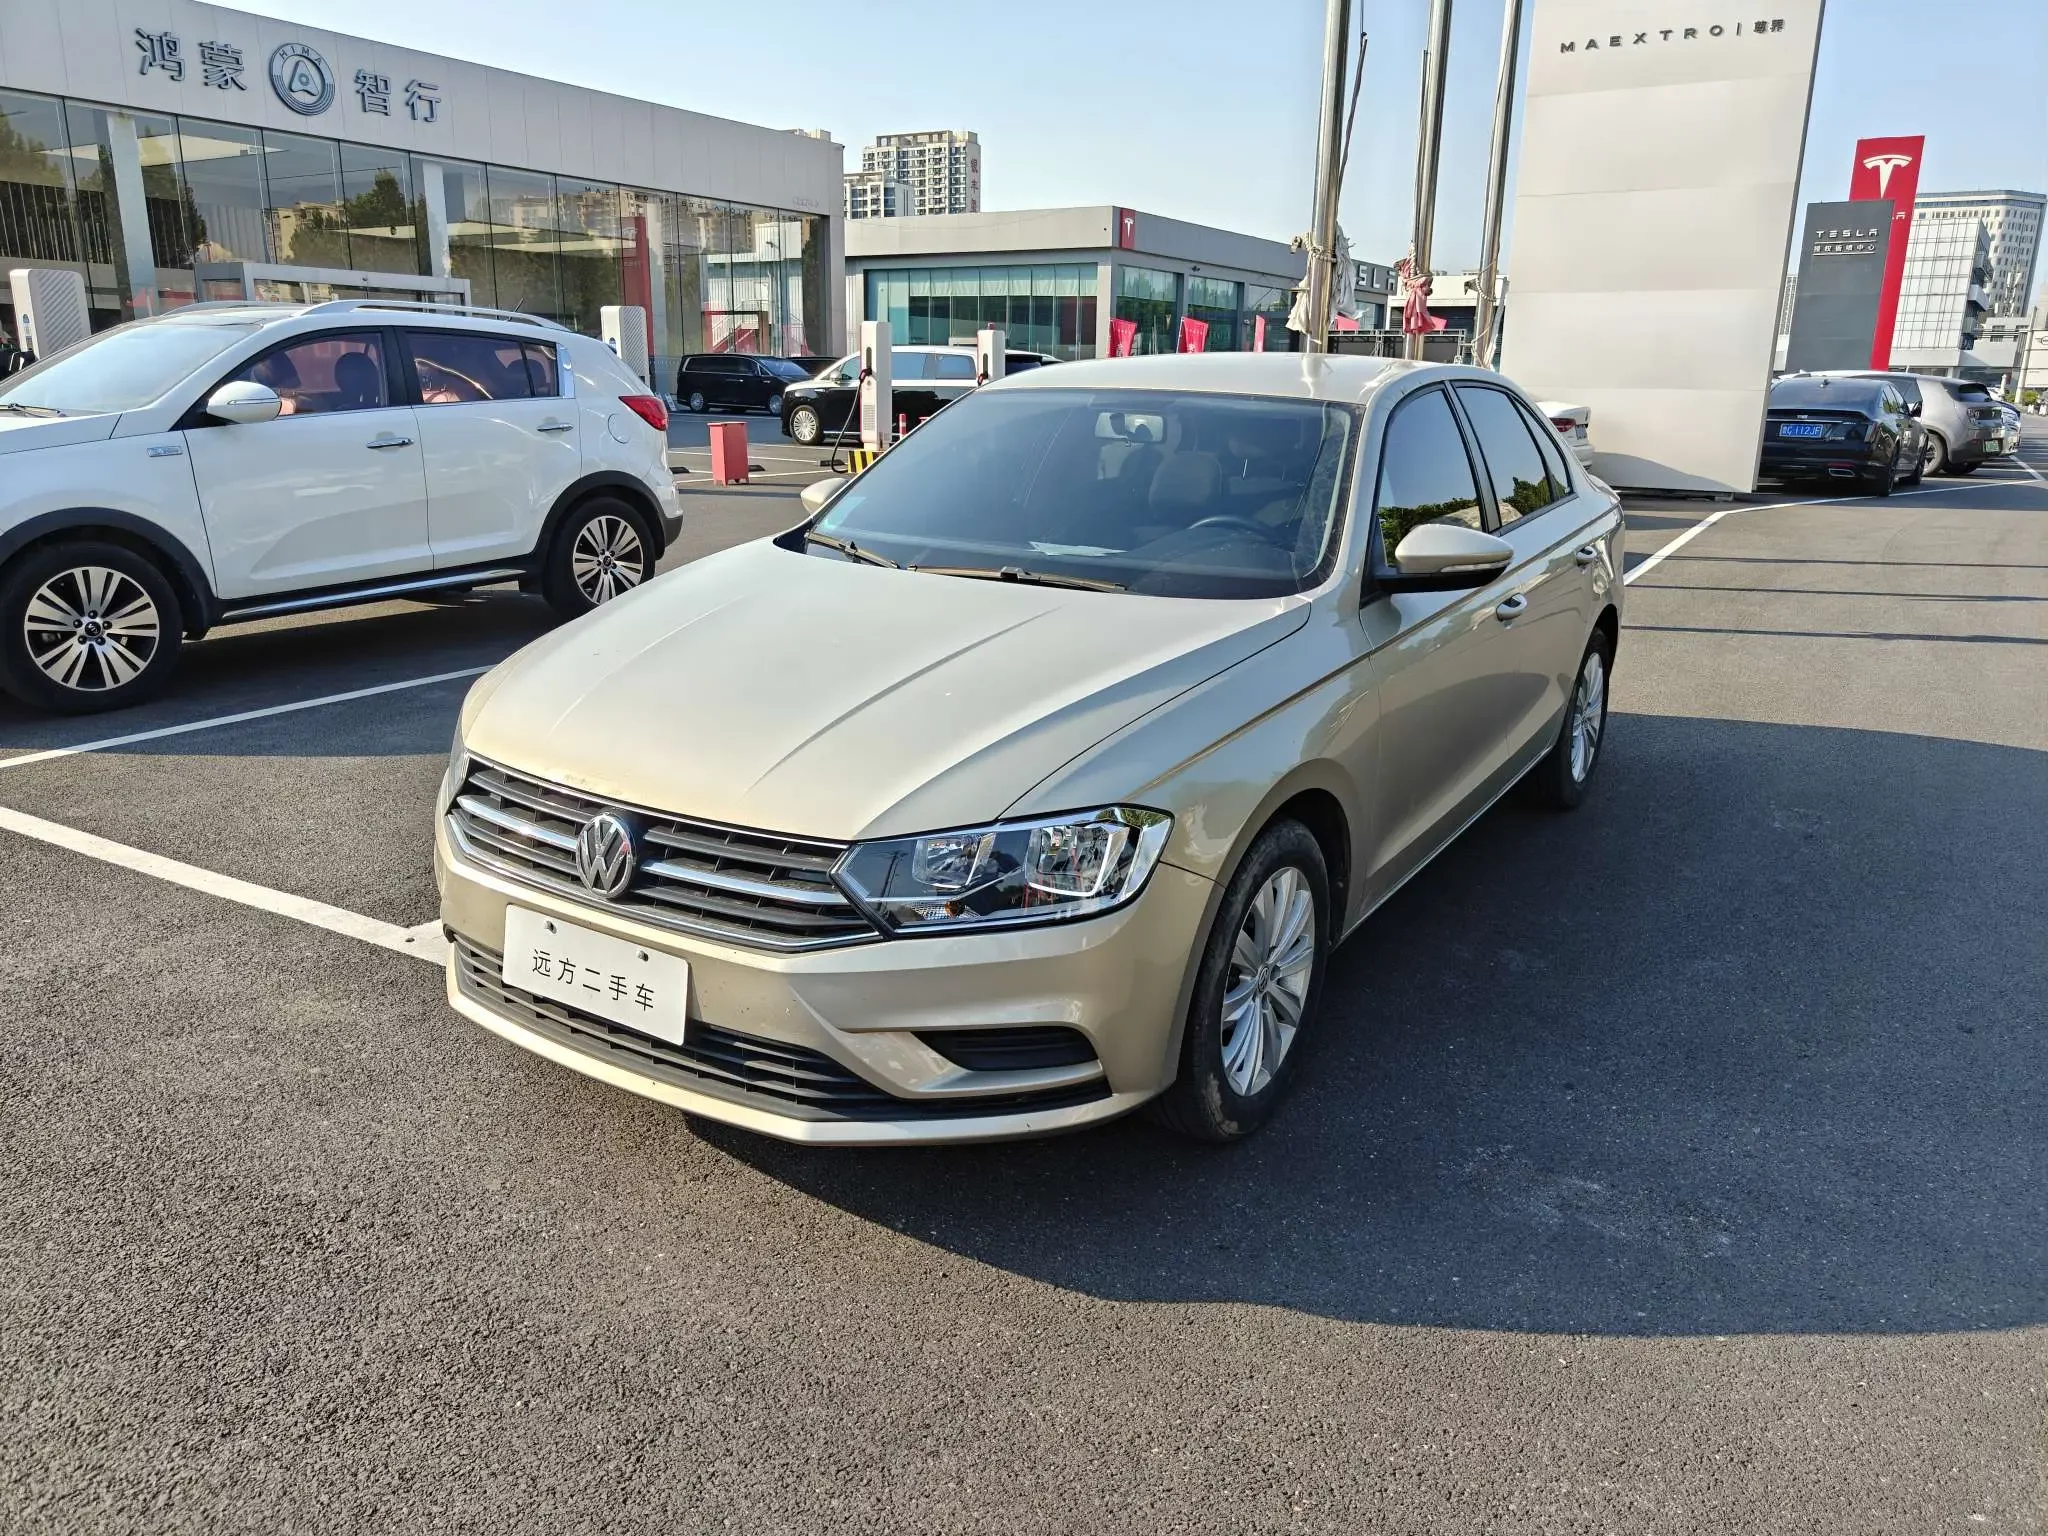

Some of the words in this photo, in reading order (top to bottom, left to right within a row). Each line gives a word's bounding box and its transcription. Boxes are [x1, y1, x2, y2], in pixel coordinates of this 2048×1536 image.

[1560, 24, 1724, 53] MAEXTRO
[1753, 18, 1785, 33] 尊界
[279, 45, 322, 66] HIMA
[135, 27, 248, 91] 鸿蒙
[354, 68, 442, 122] 智行
[1816, 228, 1878, 238] TESLA
[1358, 264, 1397, 291] SLA
[532, 949, 655, 1011] 远方二手车
